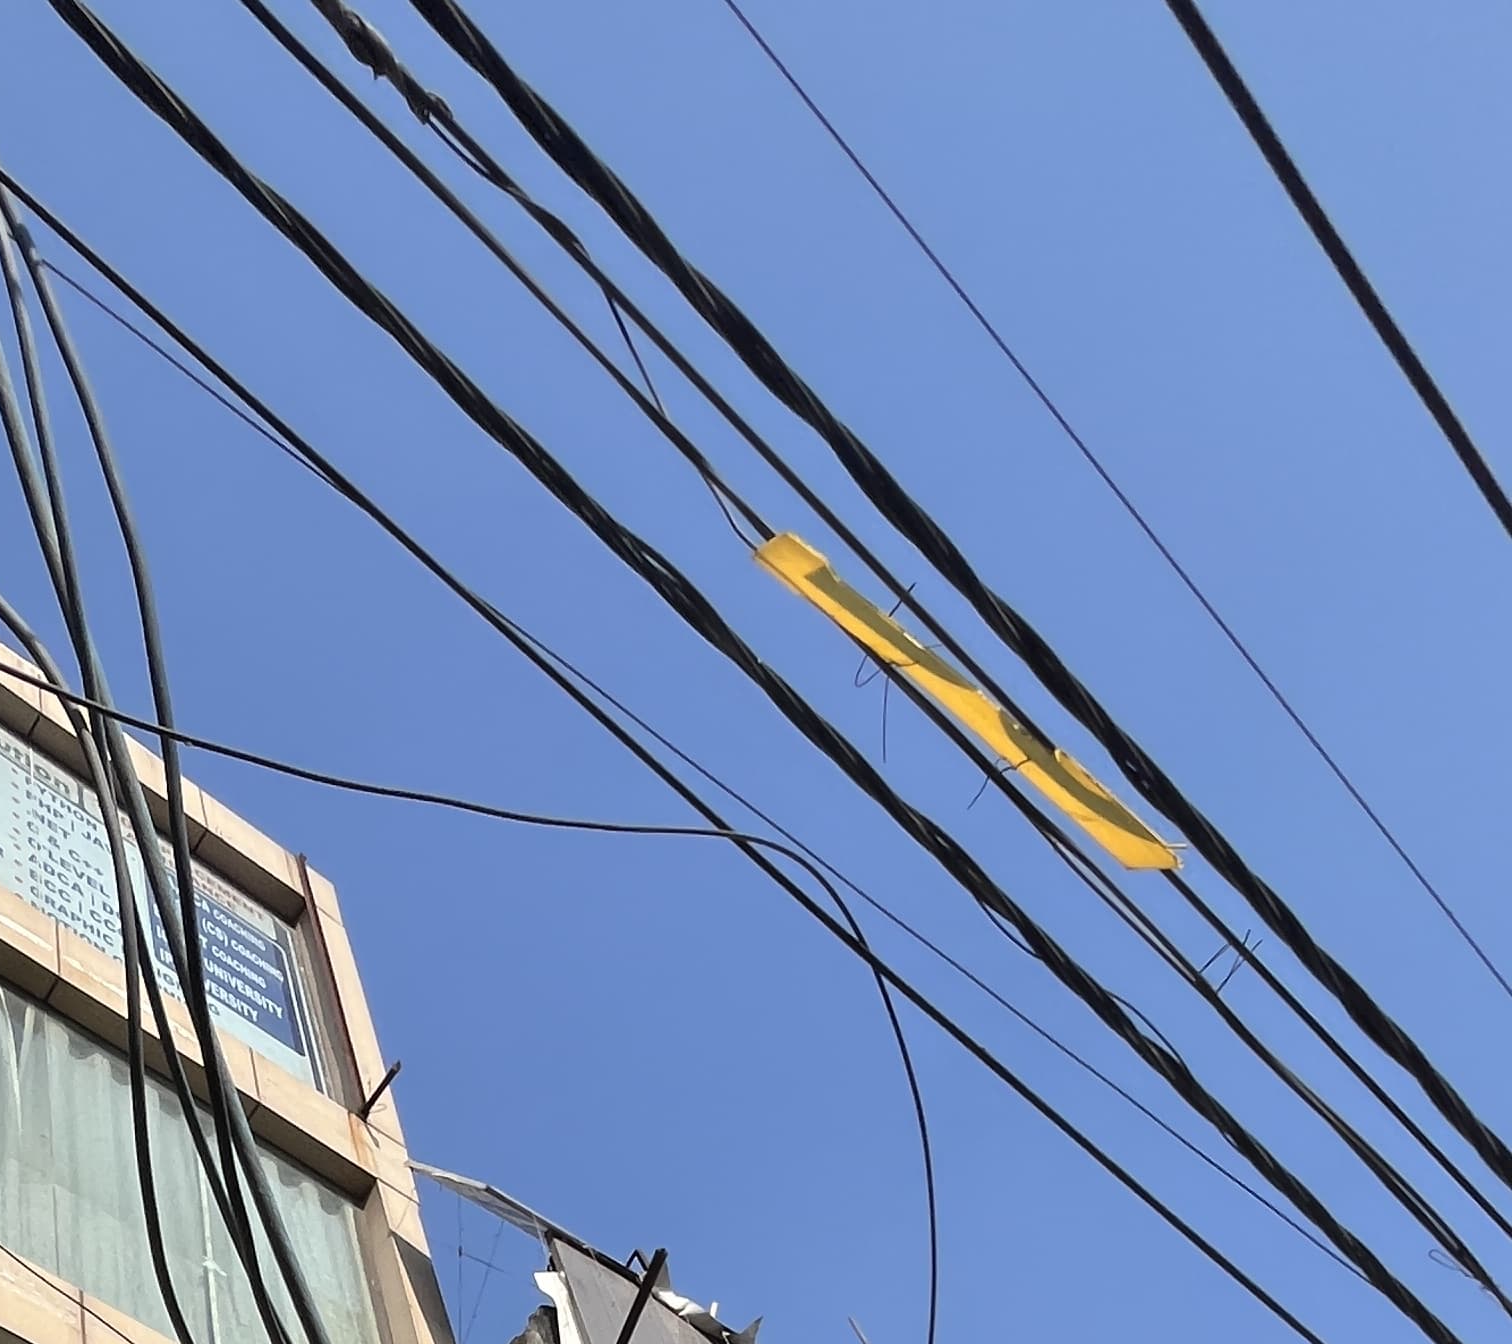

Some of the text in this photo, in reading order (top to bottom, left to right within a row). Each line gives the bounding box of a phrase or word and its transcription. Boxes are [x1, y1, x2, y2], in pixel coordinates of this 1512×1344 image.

[24, 776, 97, 831] PYTHON
[29, 884, 114, 948] GRAPHIC
[203, 957, 283, 1020] UNIVERSITY
